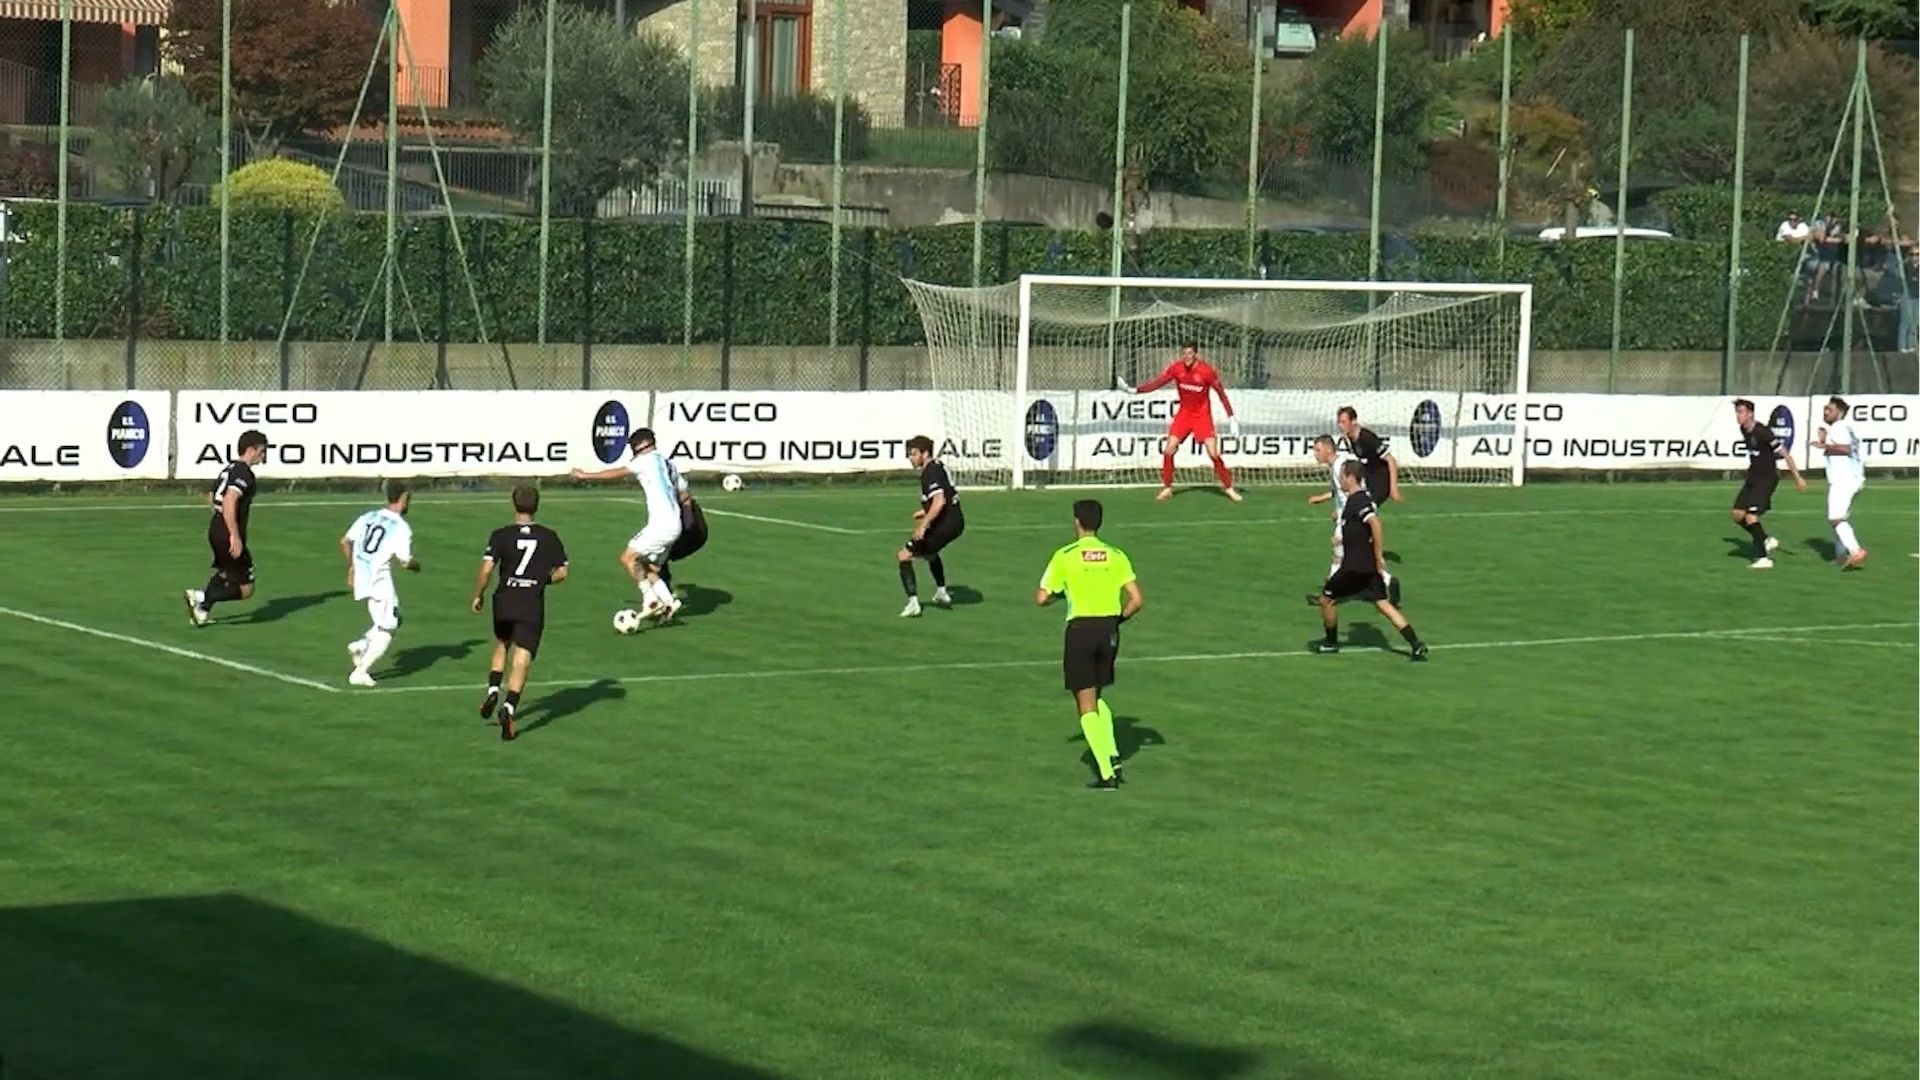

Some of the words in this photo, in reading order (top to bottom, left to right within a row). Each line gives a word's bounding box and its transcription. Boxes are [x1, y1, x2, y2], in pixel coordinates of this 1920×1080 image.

[195, 402, 317, 424] IVECO
[668, 402, 778, 422] IVECO
[1473, 403, 1564, 421] IVECO
[321, 442, 567, 464] INDUSTRIALE
[668, 440, 767, 460] AUTO
[780, 438, 1002, 461] INDUSTALE
[1563, 439, 1749, 457] INDUSTRIALE
[365, 523, 386, 554] 10
[515, 539, 538, 576] 7
